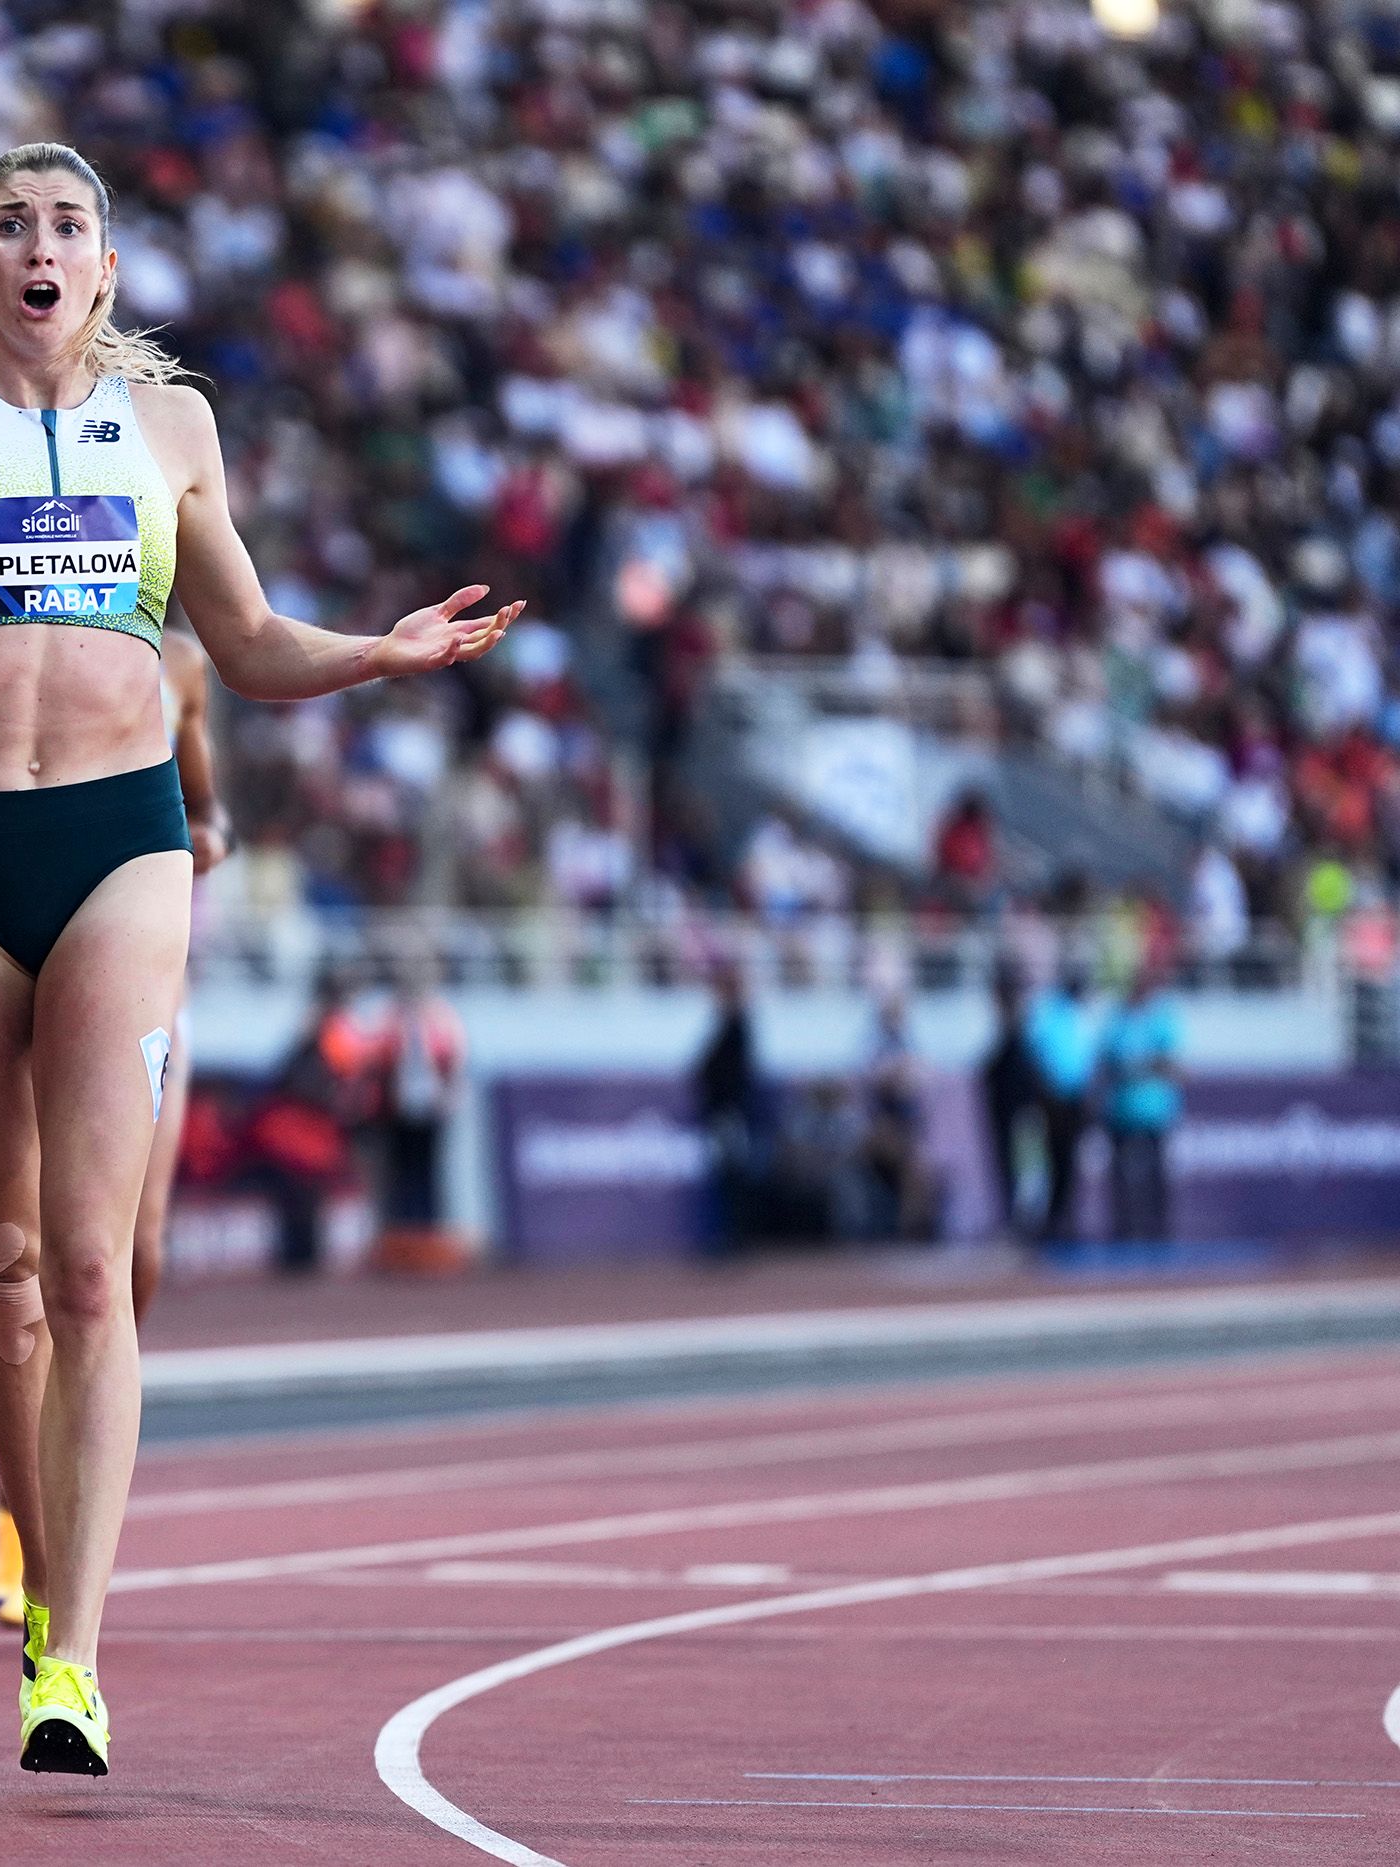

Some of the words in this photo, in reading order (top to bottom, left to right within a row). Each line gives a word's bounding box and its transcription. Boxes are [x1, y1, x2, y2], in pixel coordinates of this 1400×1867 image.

[21, 514, 54, 533] sidi
[56, 513, 80, 532] ali
[24, 589, 116, 612] RABAT
